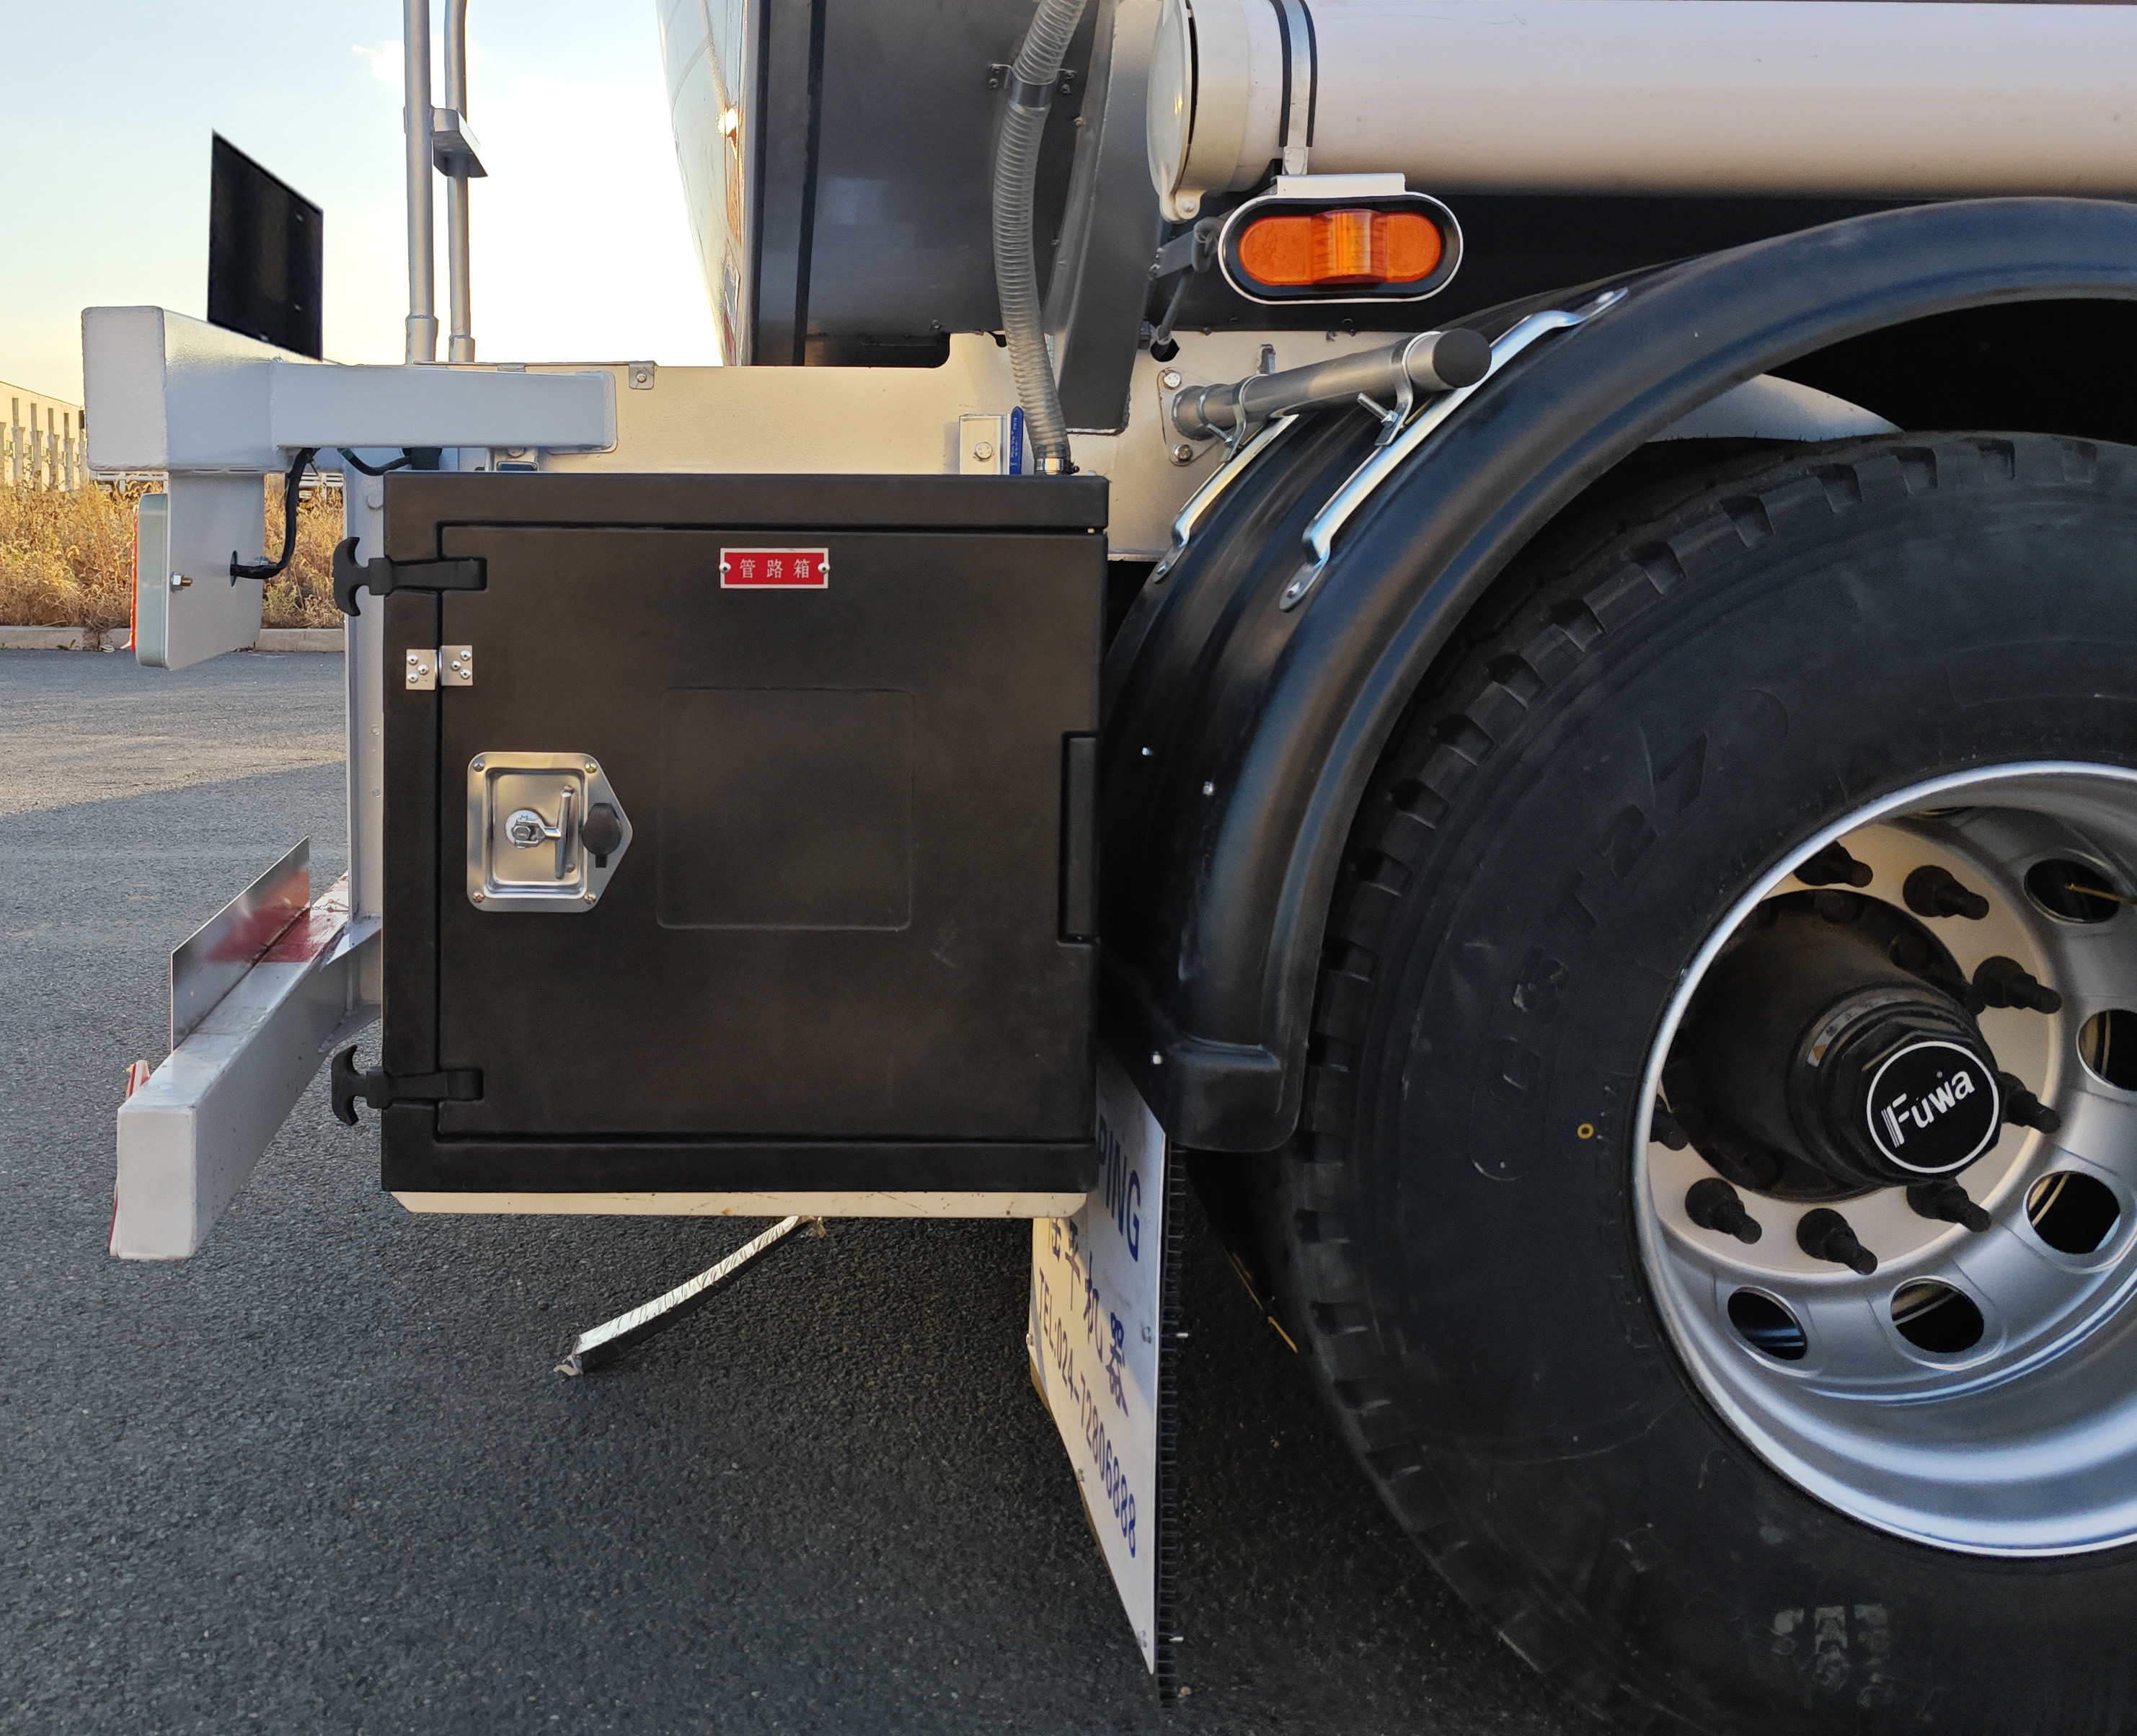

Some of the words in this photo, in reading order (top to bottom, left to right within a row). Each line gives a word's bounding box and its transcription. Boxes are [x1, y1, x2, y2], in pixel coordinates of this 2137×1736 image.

[739, 558, 810, 579] 管路箱
[1880, 1071, 1975, 1148] Fuwa
